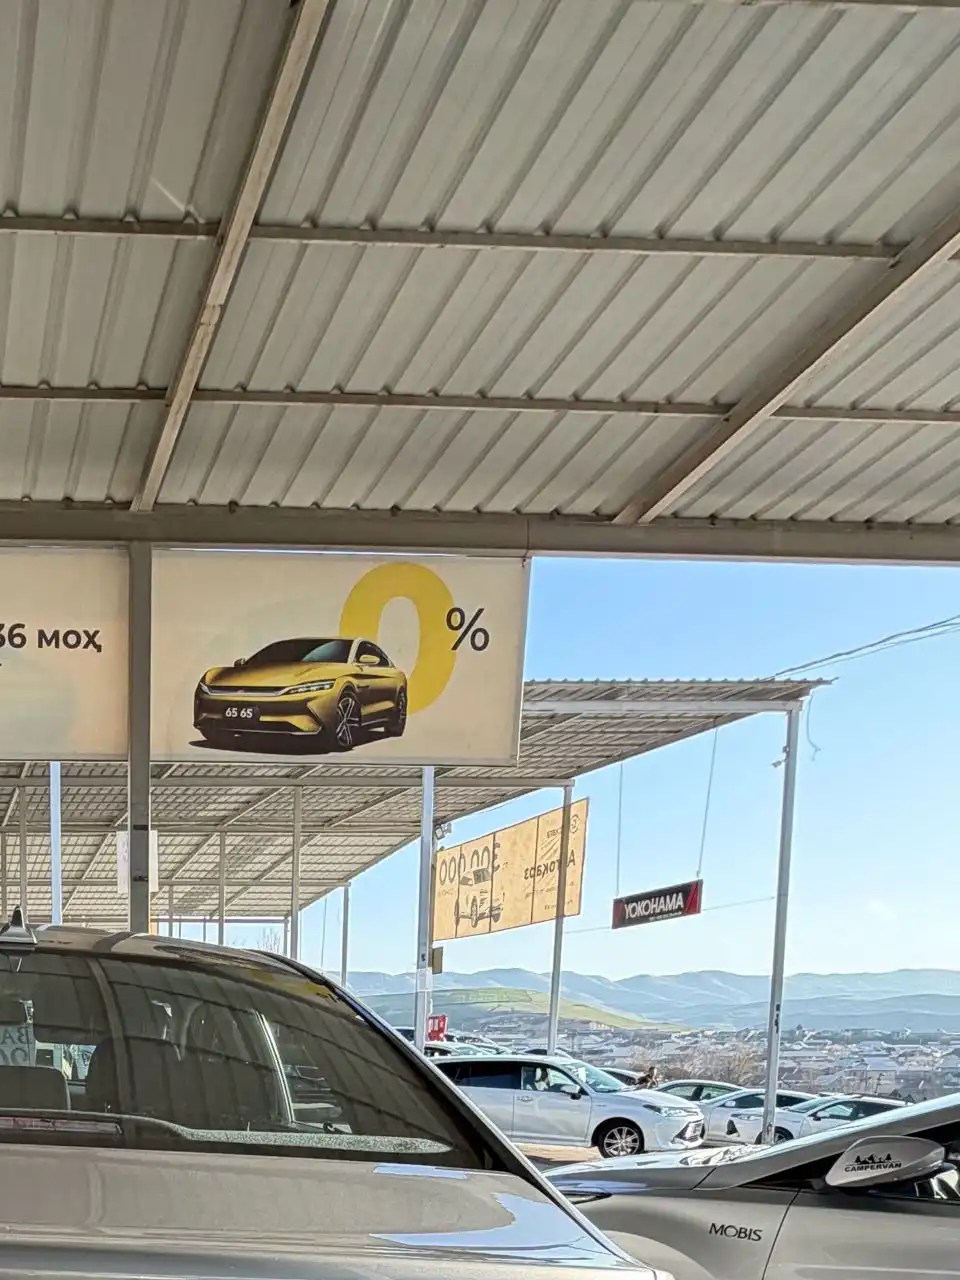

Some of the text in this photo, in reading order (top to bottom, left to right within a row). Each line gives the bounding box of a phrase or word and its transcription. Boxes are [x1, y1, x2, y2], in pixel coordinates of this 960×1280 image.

[37, 629, 103, 653] моҳ
[623, 892, 684, 920] YOKOHAMA
[844, 1162, 902, 1173] CAMPERVAN
[708, 1222, 763, 1242] MOBIS
